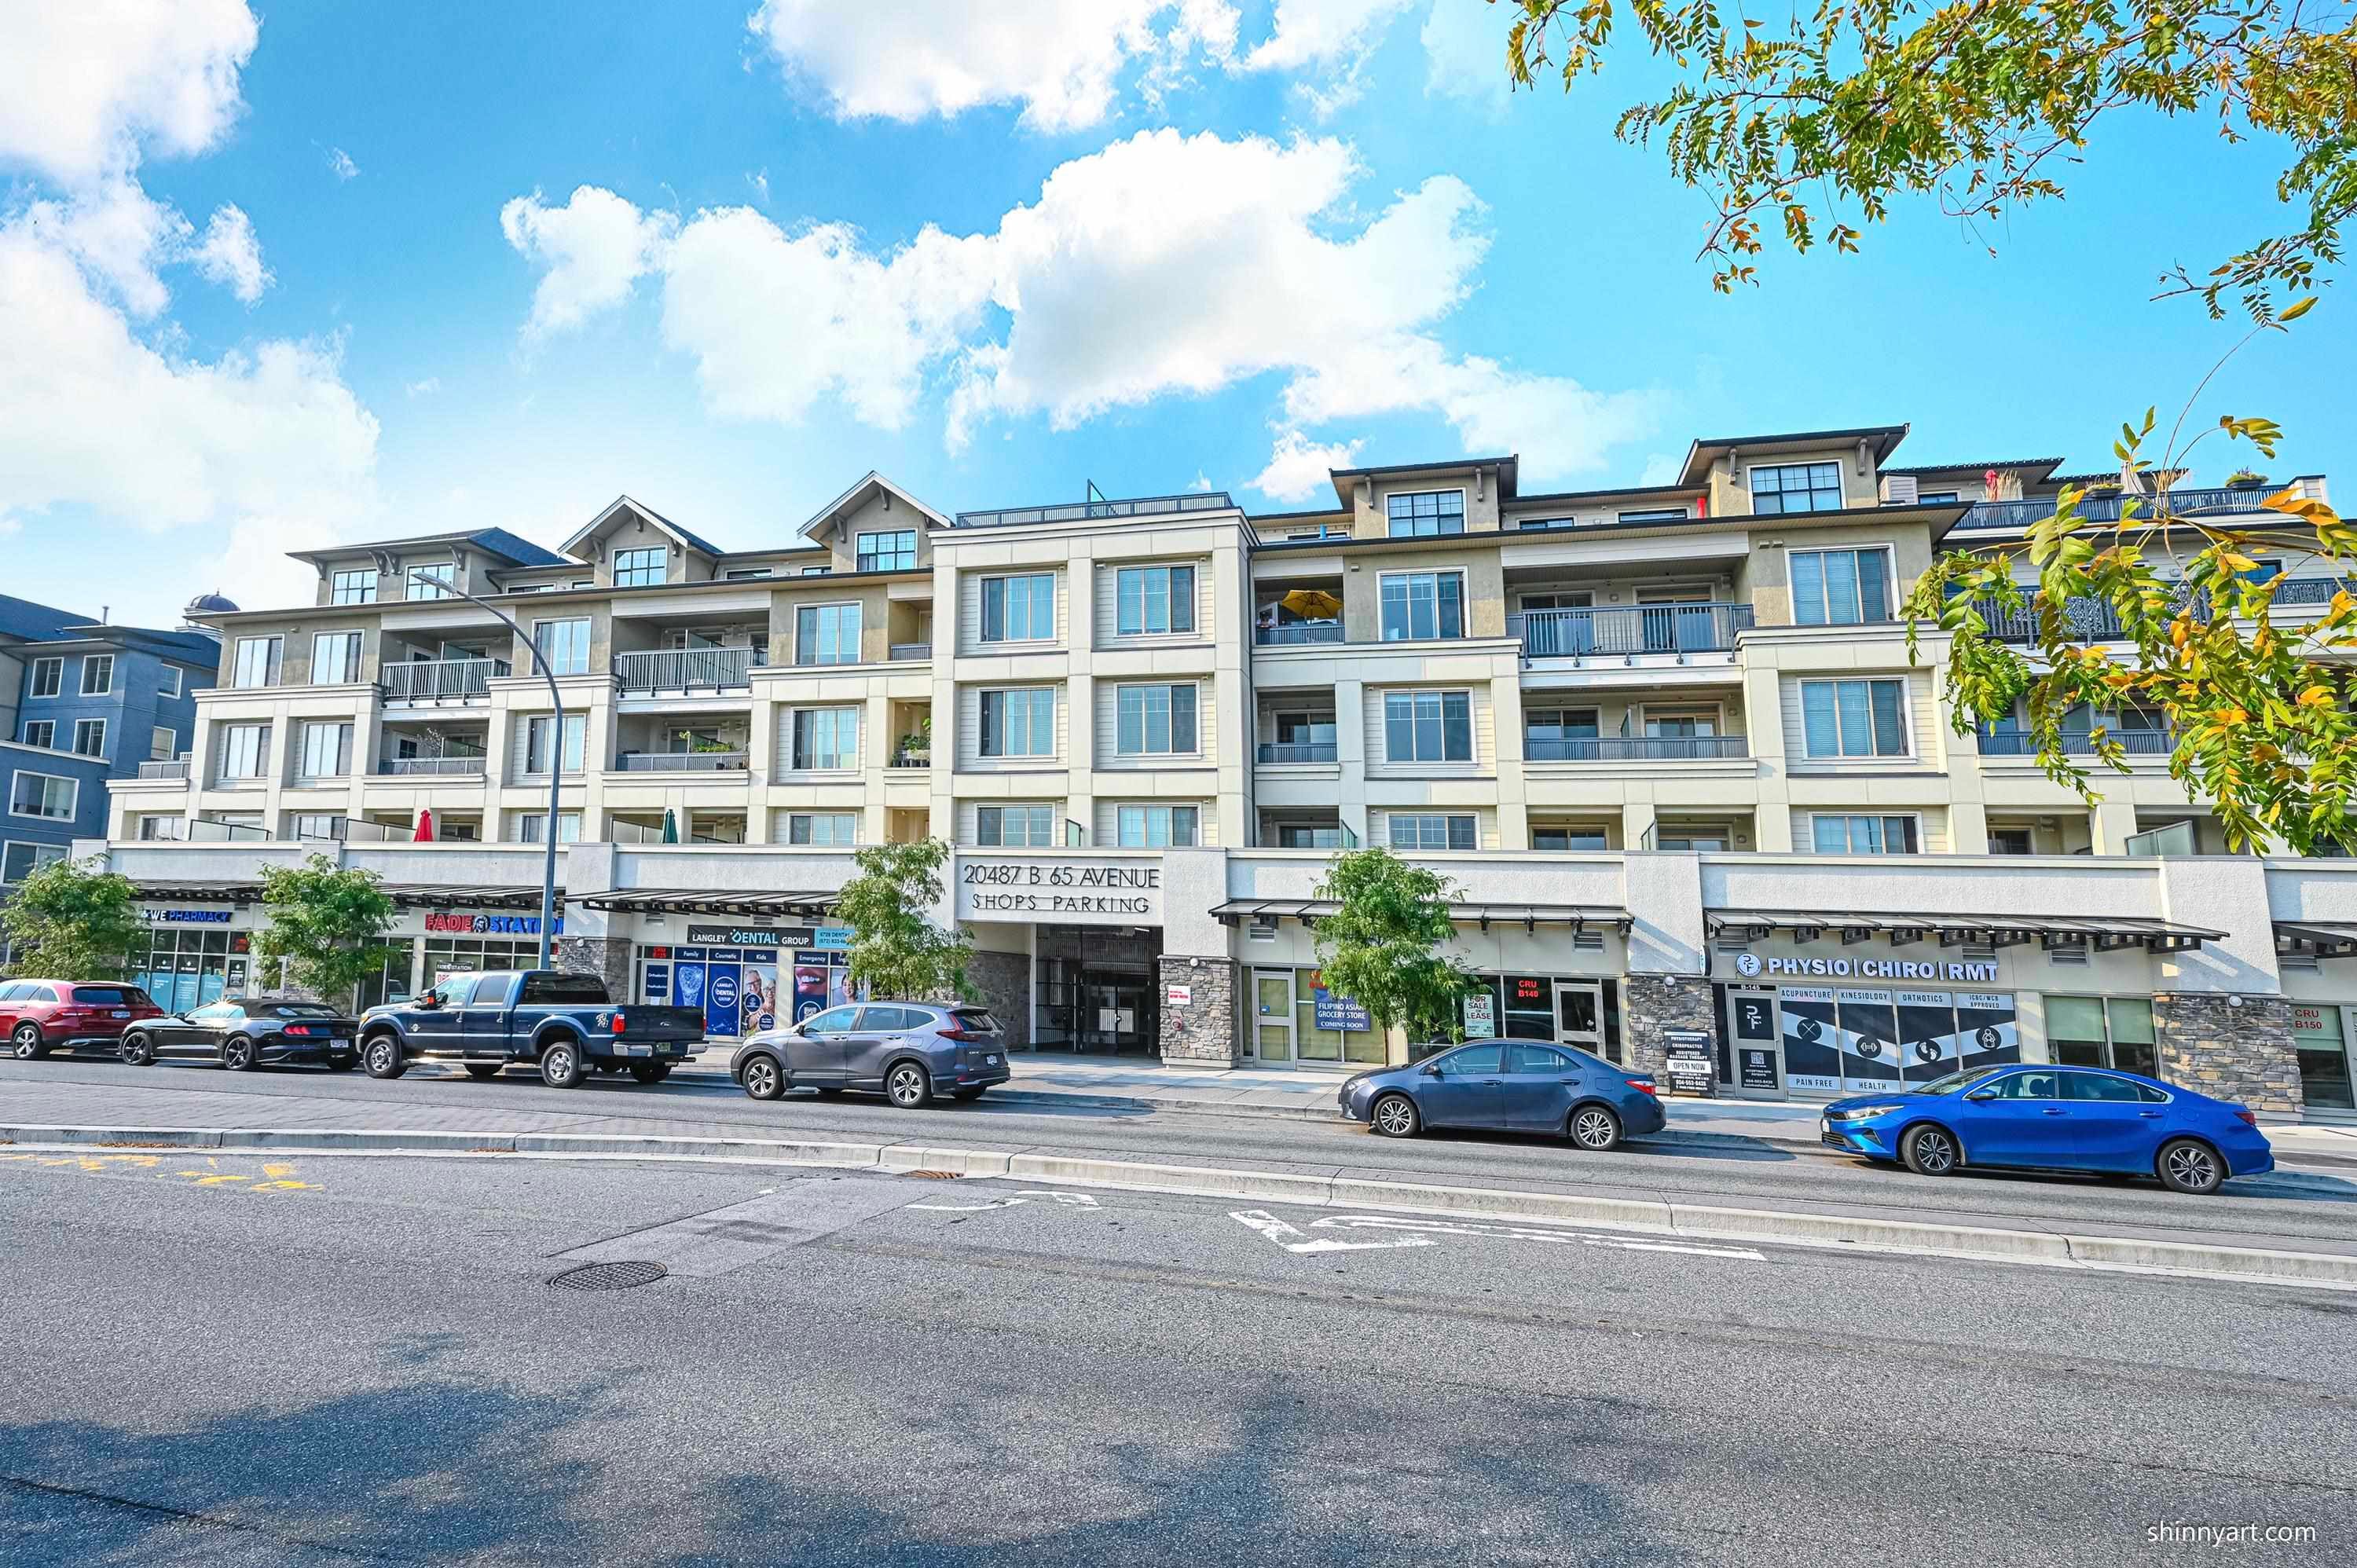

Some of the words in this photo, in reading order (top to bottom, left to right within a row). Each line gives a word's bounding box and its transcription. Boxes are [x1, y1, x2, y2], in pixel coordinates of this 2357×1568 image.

[964, 865, 1021, 884] 20487
[1029, 866, 1041, 885] B
[1050, 866, 1072, 885] 65
[1080, 867, 1160, 888] AVENUE
[973, 894, 1036, 910] SHOPS
[1053, 896, 1149, 913] PARKING
[151, 910, 167, 921] WE
[169, 911, 228, 922] PHARMACY
[425, 914, 472, 932] FADE
[692, 933, 726, 943] LANGLEY
[730, 929, 778, 944] DENTAL
[781, 936, 809, 945] GROUP
[1768, 957, 1848, 976] PHYSIO
[1861, 959, 1935, 980] CHIRO
[1948, 962, 1998, 981] RMT
[1518, 980, 1538, 988] CRU
[1841, 991, 1887, 1000] KINESIOLOGY
[2295, 1009, 2319, 1018] CRU
[2295, 1020, 2322, 1029] B150
